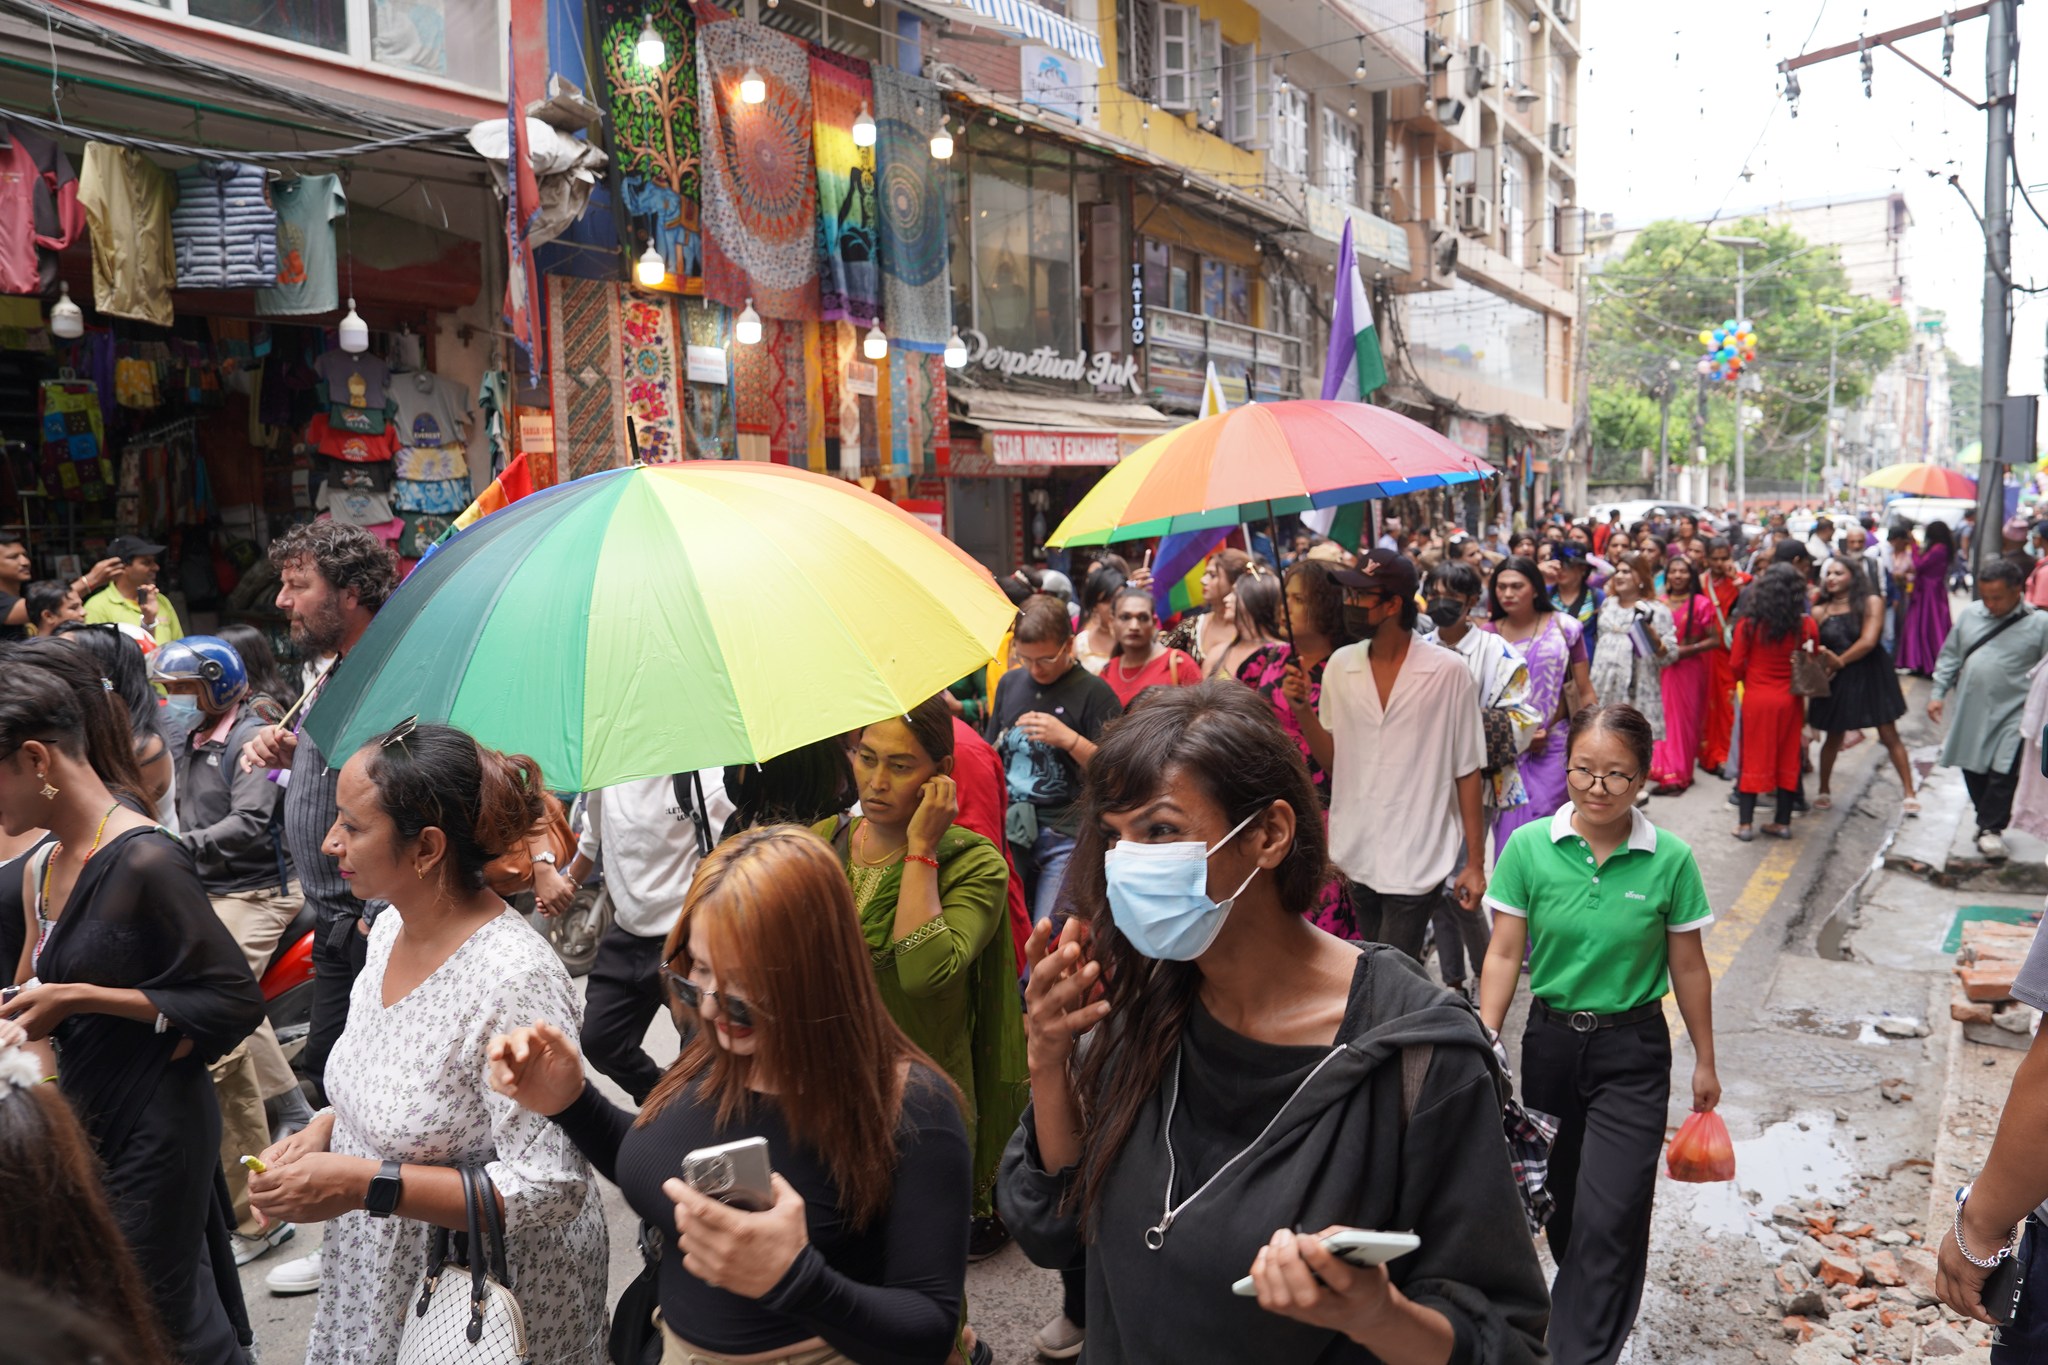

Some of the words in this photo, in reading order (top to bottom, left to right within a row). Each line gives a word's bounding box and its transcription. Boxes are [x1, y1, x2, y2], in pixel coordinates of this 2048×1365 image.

[1131, 263, 1145, 345] TATTOO
[960, 329, 1087, 383] Perpetual
[1087, 352, 1142, 394] Ink
[414, 431, 441, 440] EVEREST
[993, 434, 1023, 462] STAR
[1024, 435, 1062, 462] MONEY
[1063, 435, 1119, 463] EXCHANGE
